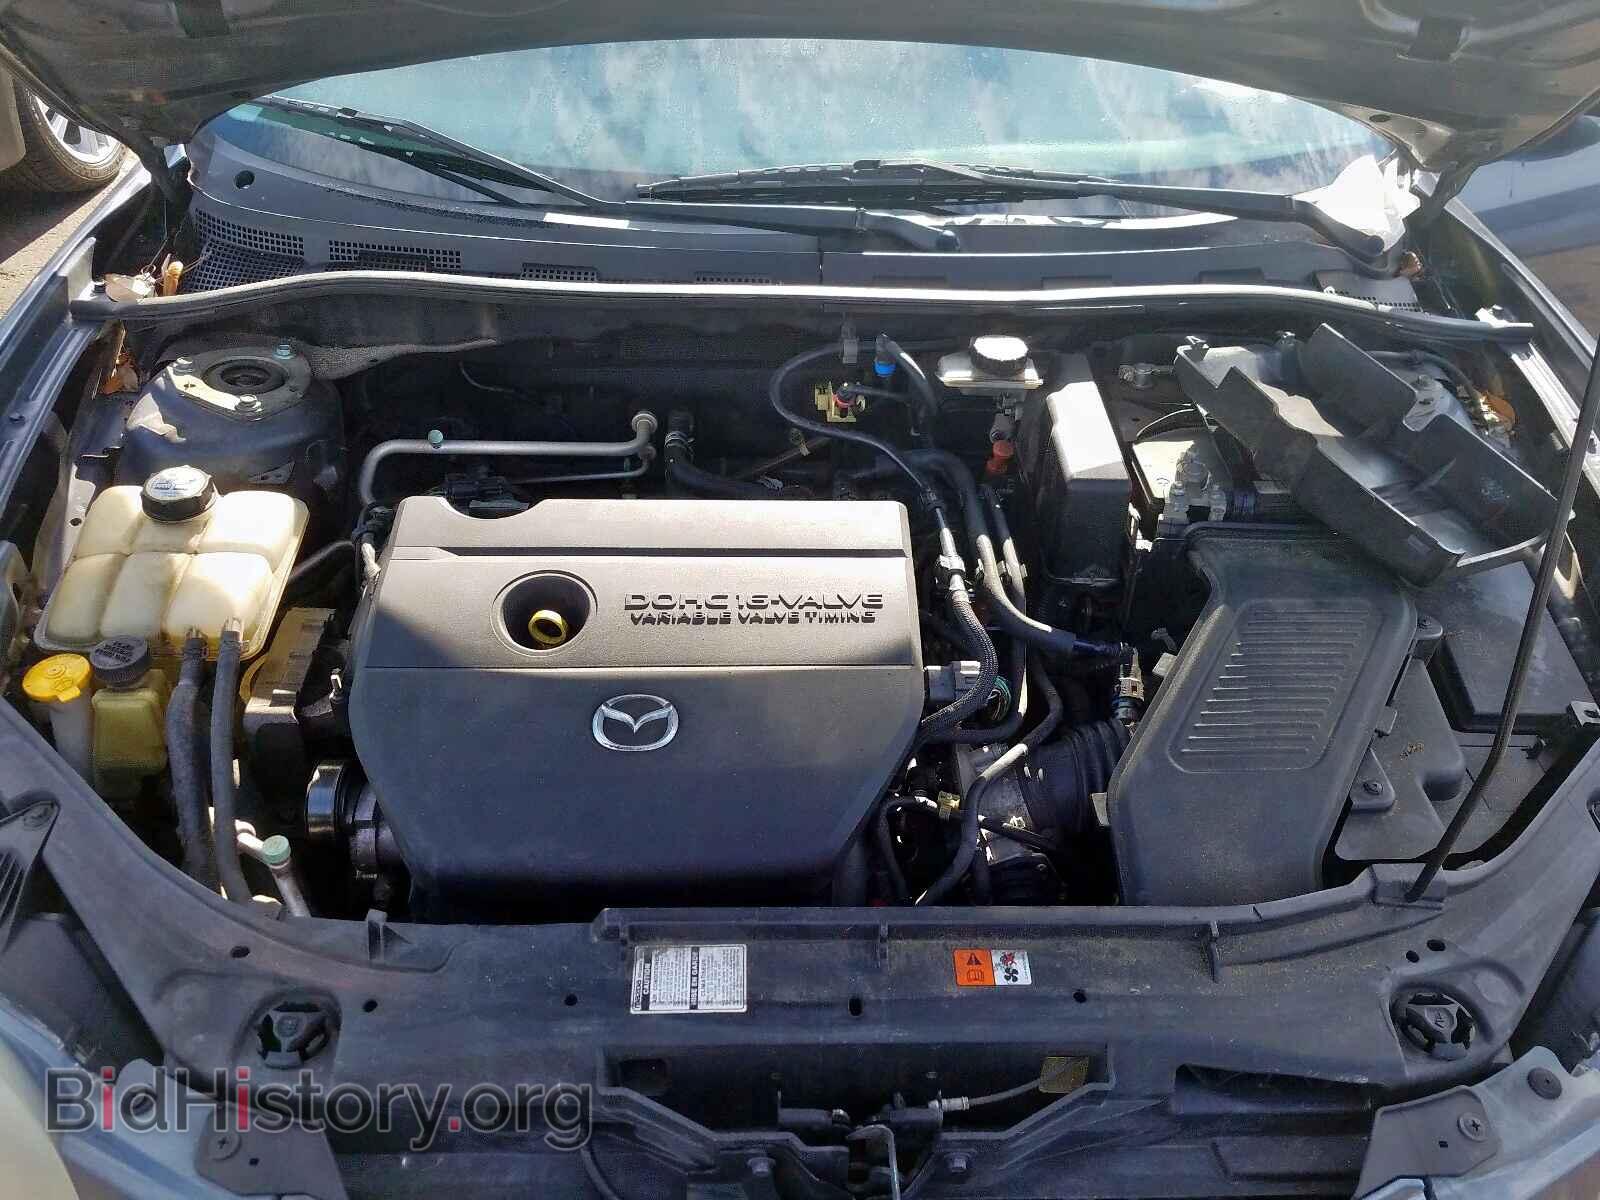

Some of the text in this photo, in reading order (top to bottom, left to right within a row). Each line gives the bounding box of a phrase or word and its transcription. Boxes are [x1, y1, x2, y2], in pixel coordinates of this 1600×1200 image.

[624, 593, 884, 610] DOHC 16-VALVE
[630, 610, 876, 625] VARIABLE VALVE TIMING
[643, 963, 651, 995] CAUTION
